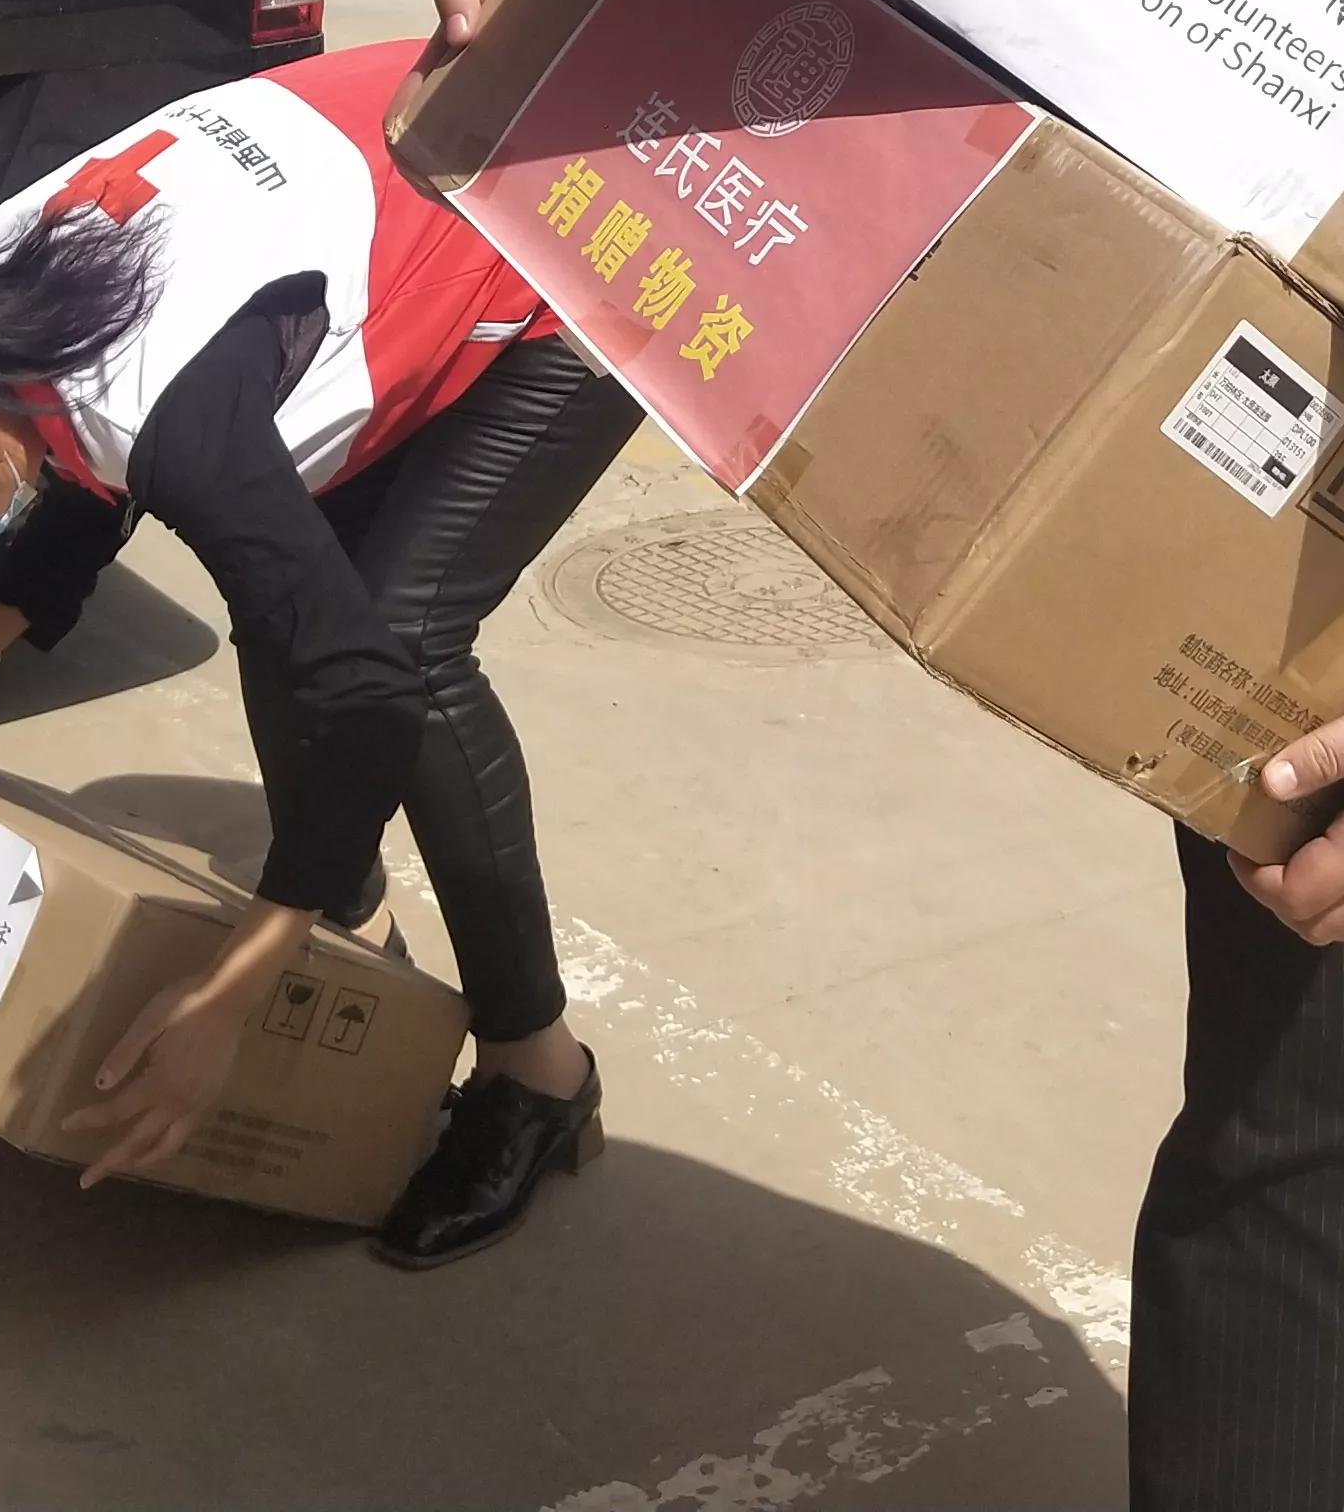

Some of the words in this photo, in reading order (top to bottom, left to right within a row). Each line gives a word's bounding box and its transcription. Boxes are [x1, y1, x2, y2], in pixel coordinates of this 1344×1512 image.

[1186, 22, 1232, 53] of
[1222, 40, 1338, 131] Shanxi
[616, 91, 809, 265] 连氏医疗
[536, 157, 754, 381] 捐赠物资
